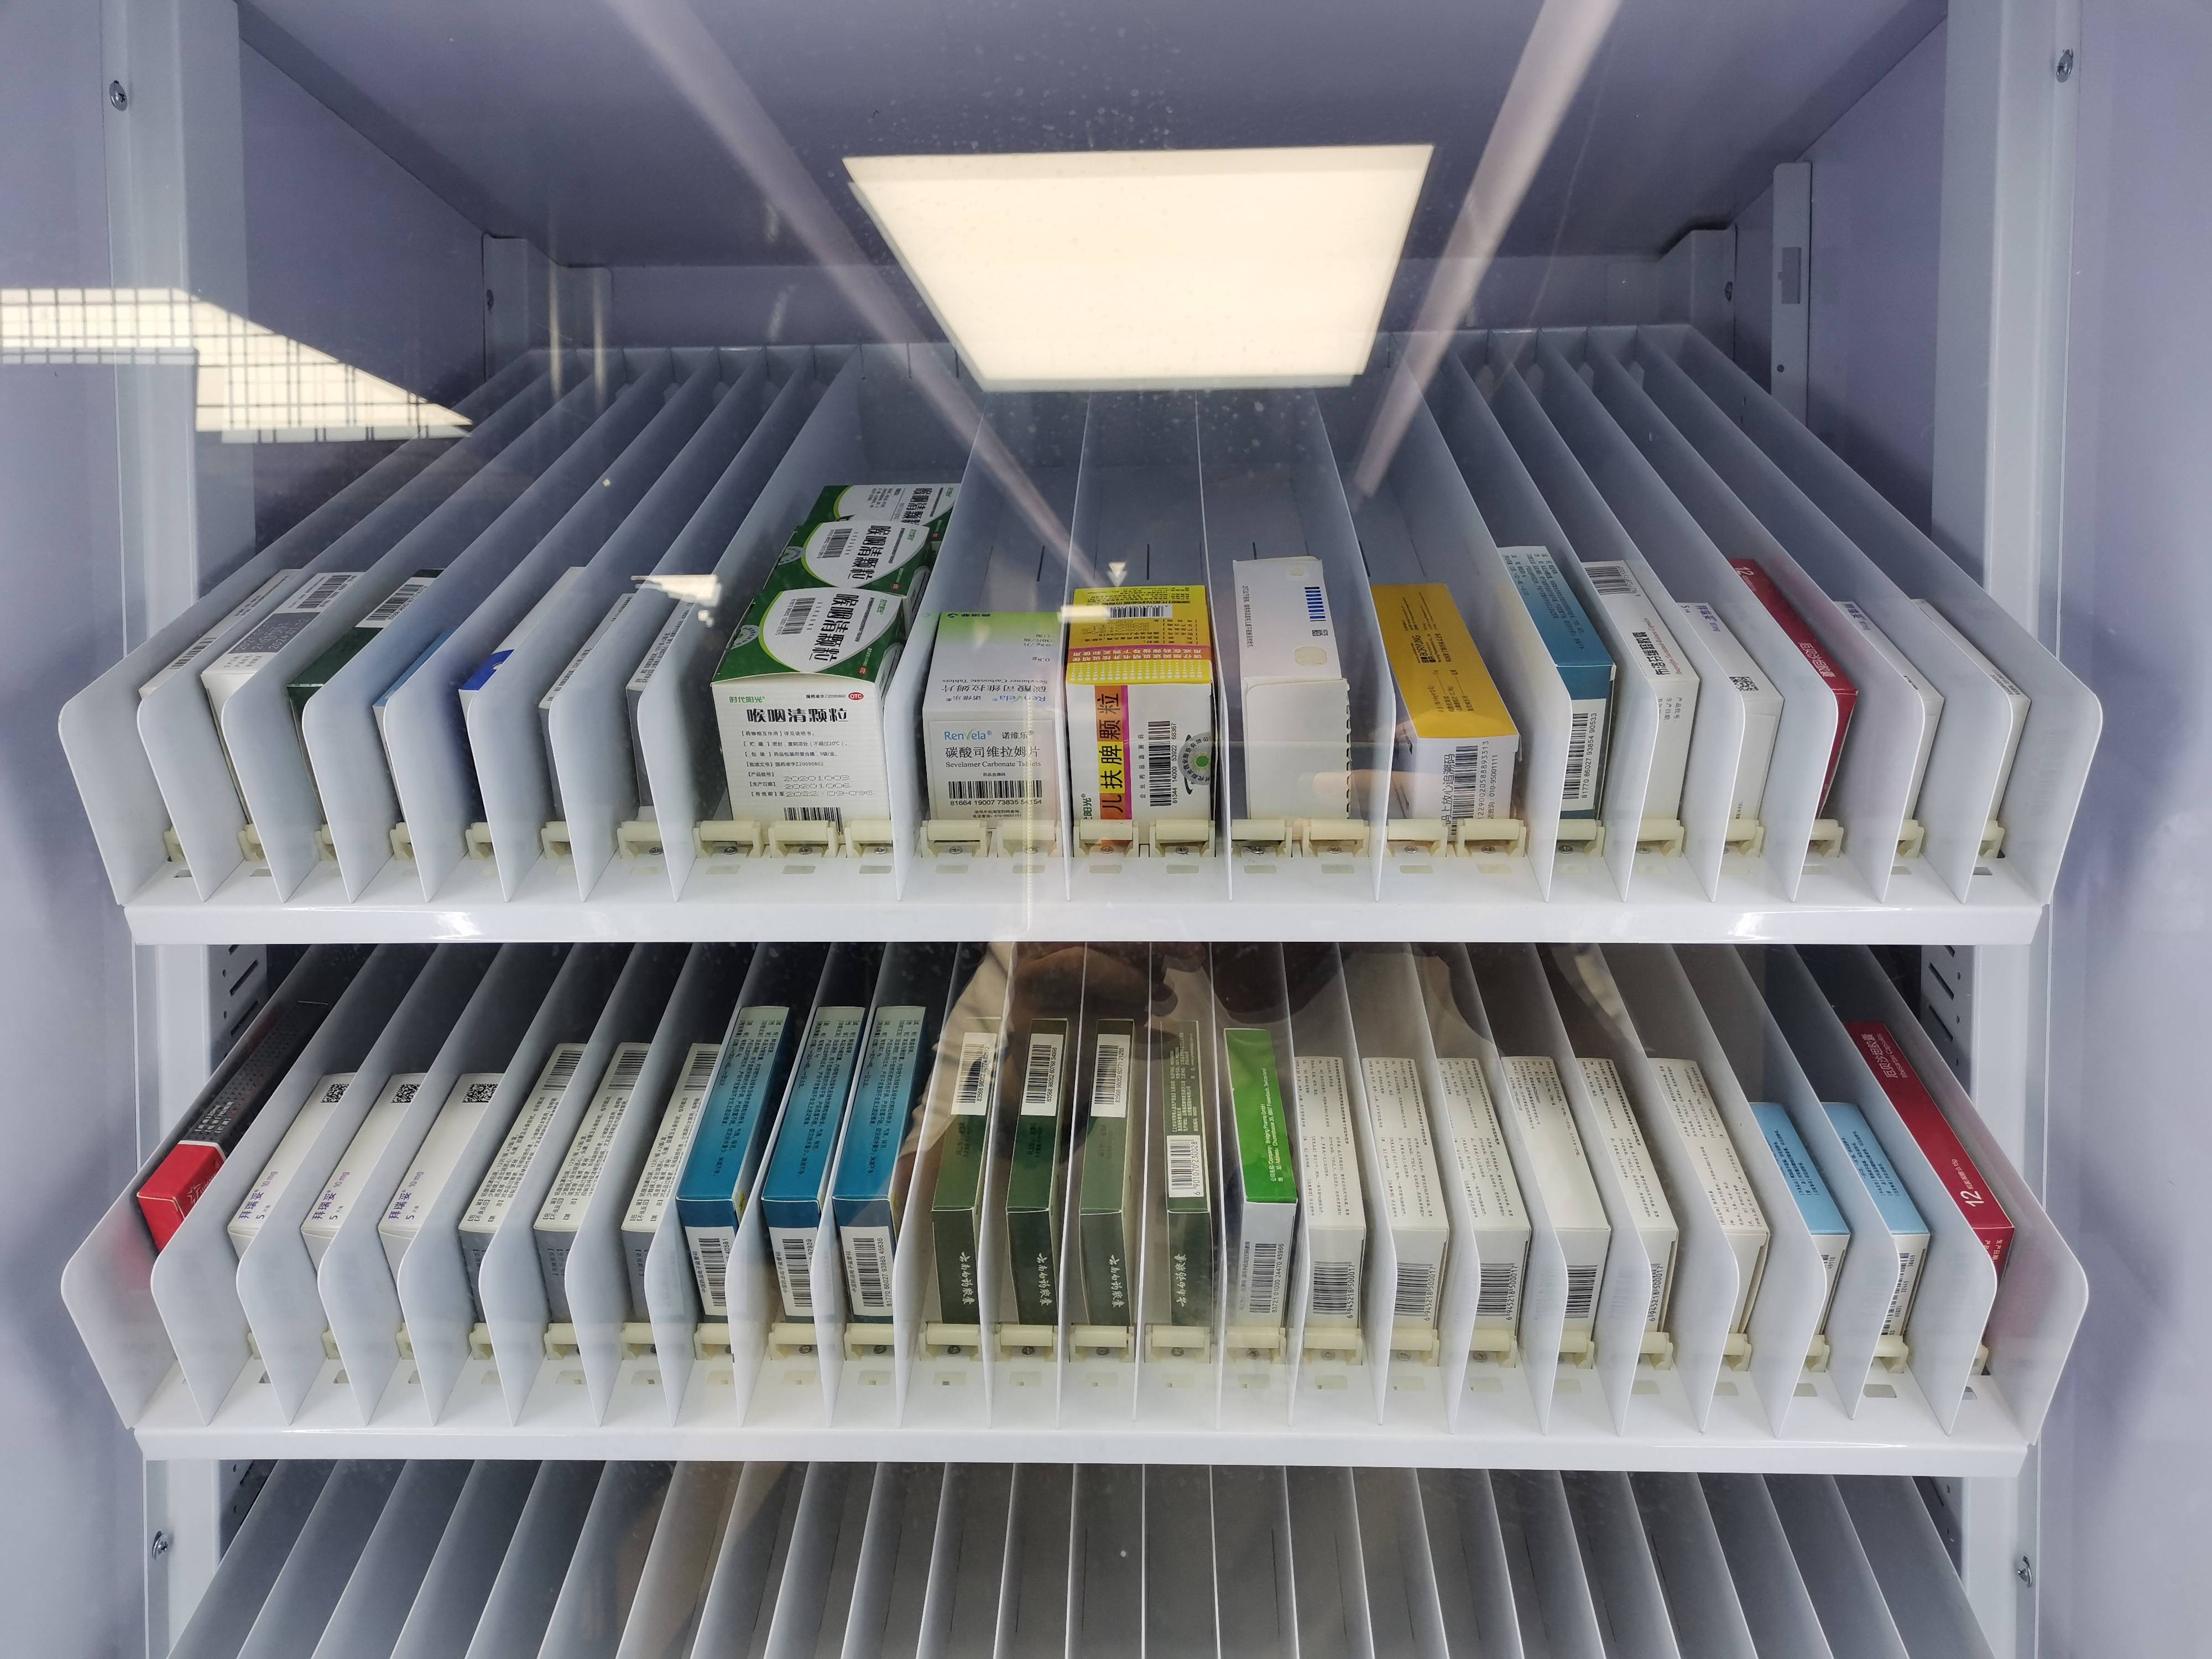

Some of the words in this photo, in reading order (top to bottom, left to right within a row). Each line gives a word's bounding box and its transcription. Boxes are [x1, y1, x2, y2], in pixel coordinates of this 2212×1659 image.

[848, 525, 892, 580] 喉咽清颗粒
[1735, 566, 1755, 576] 12
[809, 593, 859, 661] 喉咽清颗粒
[747, 708, 848, 723] 喉咽清颗粒
[945, 745, 1040, 758] 碳酸司维拉姆片
[1097, 693, 1124, 813] 儿扶脾颗粒
[1859, 1034, 1900, 1078] 厄贝沙坦胶囊
[1958, 1191, 1986, 1206] 12
[1427, 1266, 1436, 1291] 500017
[1510, 1266, 1519, 1290] 500017
[1650, 1290, 1660, 1316] 945218
[1655, 1265, 1664, 1290] 500017
[1425, 1291, 1433, 1316] 945218
[1506, 1291, 1515, 1315] 945218
